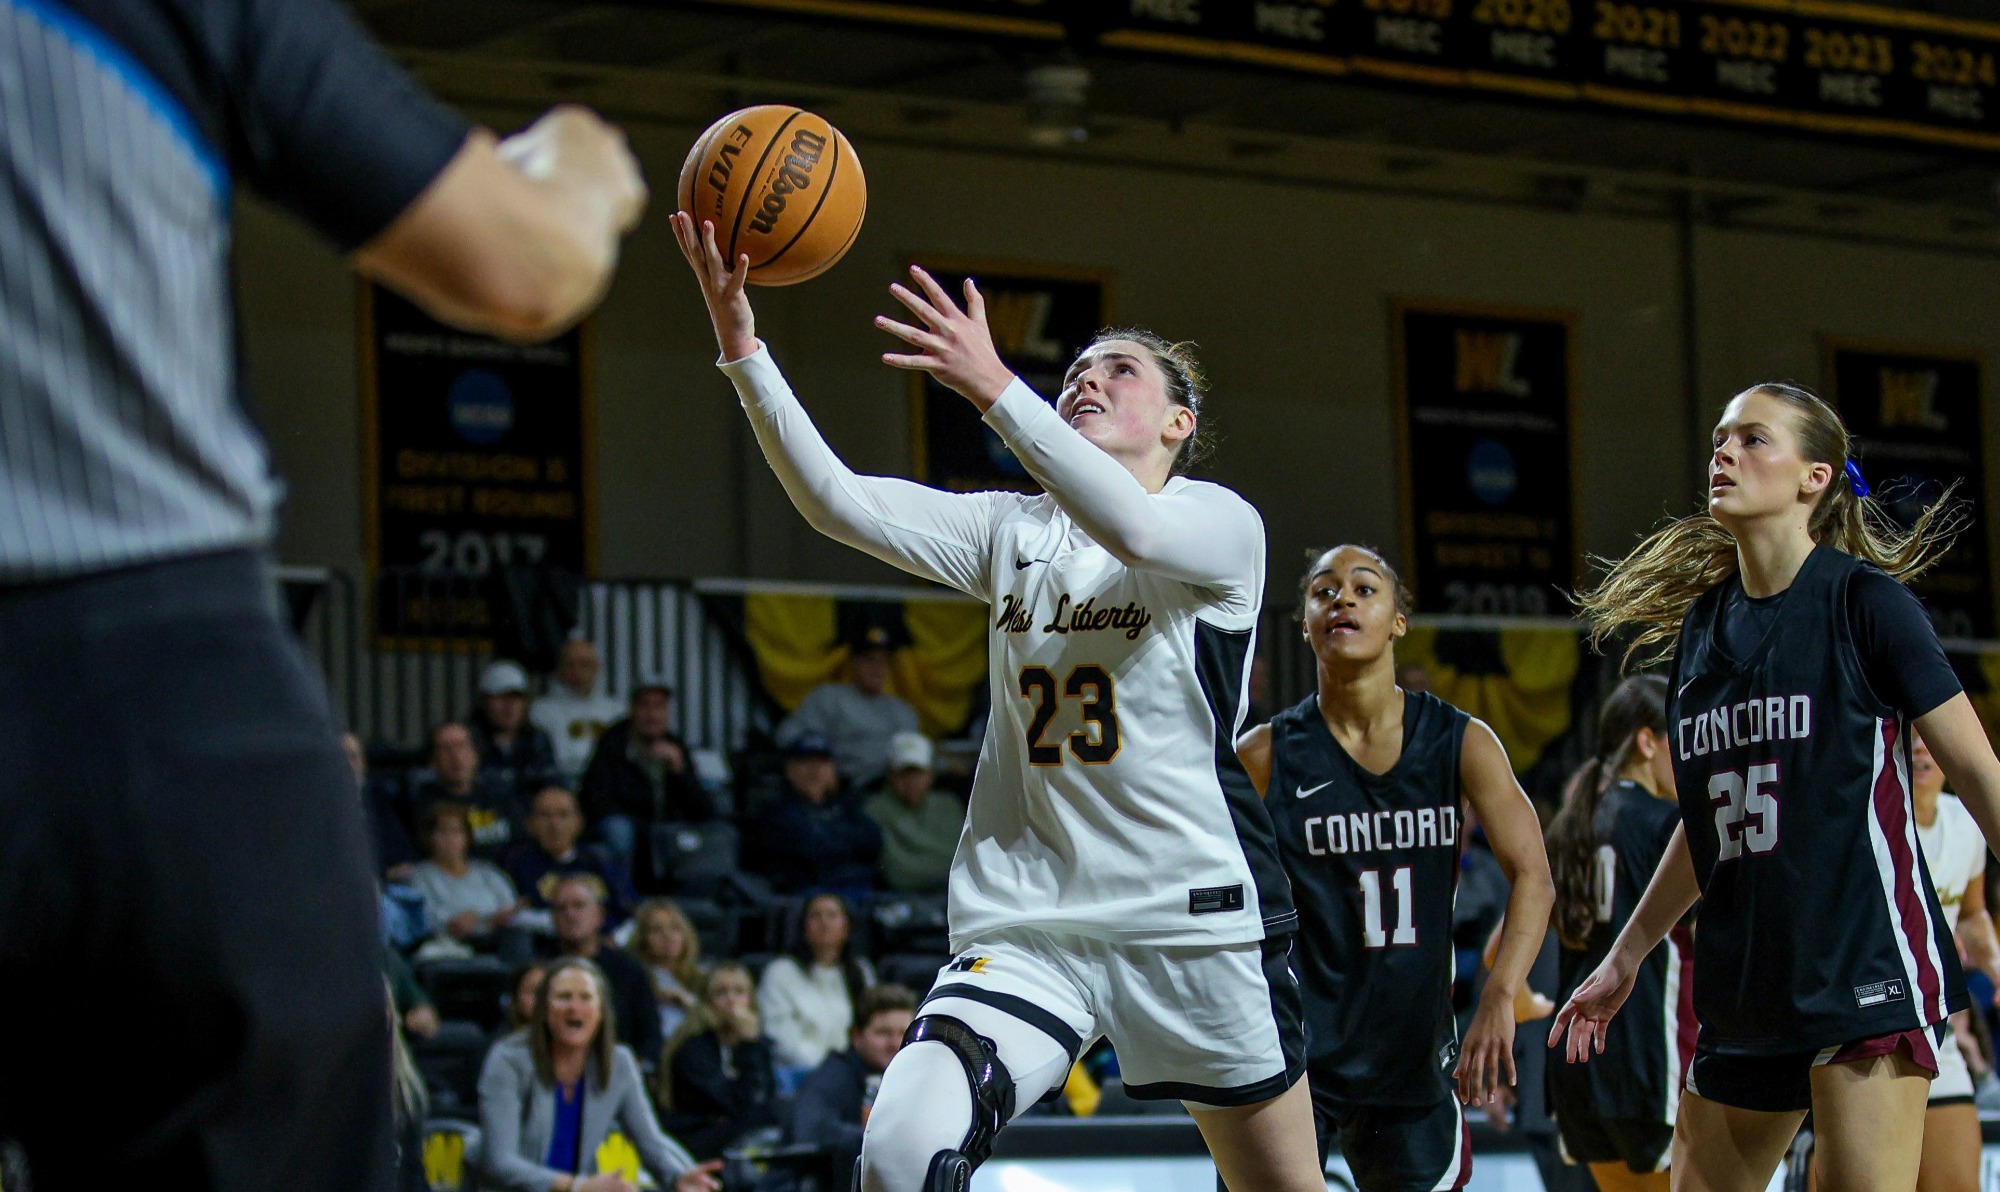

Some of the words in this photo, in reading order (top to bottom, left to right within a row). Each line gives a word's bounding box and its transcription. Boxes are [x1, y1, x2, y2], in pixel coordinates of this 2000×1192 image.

[1592, 0, 1682, 48] 2021
[1699, 14, 1791, 63] 2022
[1802, 27, 1895, 75] 2023
[709, 125, 753, 193] EVO
[748, 129, 827, 234] Wilson
[1043, 592, 1152, 641] Liberty
[1018, 663, 1122, 767] 23
[1678, 694, 1811, 762] CONCORD
[1304, 805, 1456, 856] CONCORD
[1706, 762, 1780, 862] 25
[1229, 893, 1236, 903] L
[1358, 865, 1418, 948] 11
[1887, 985, 1902, 996] XL
